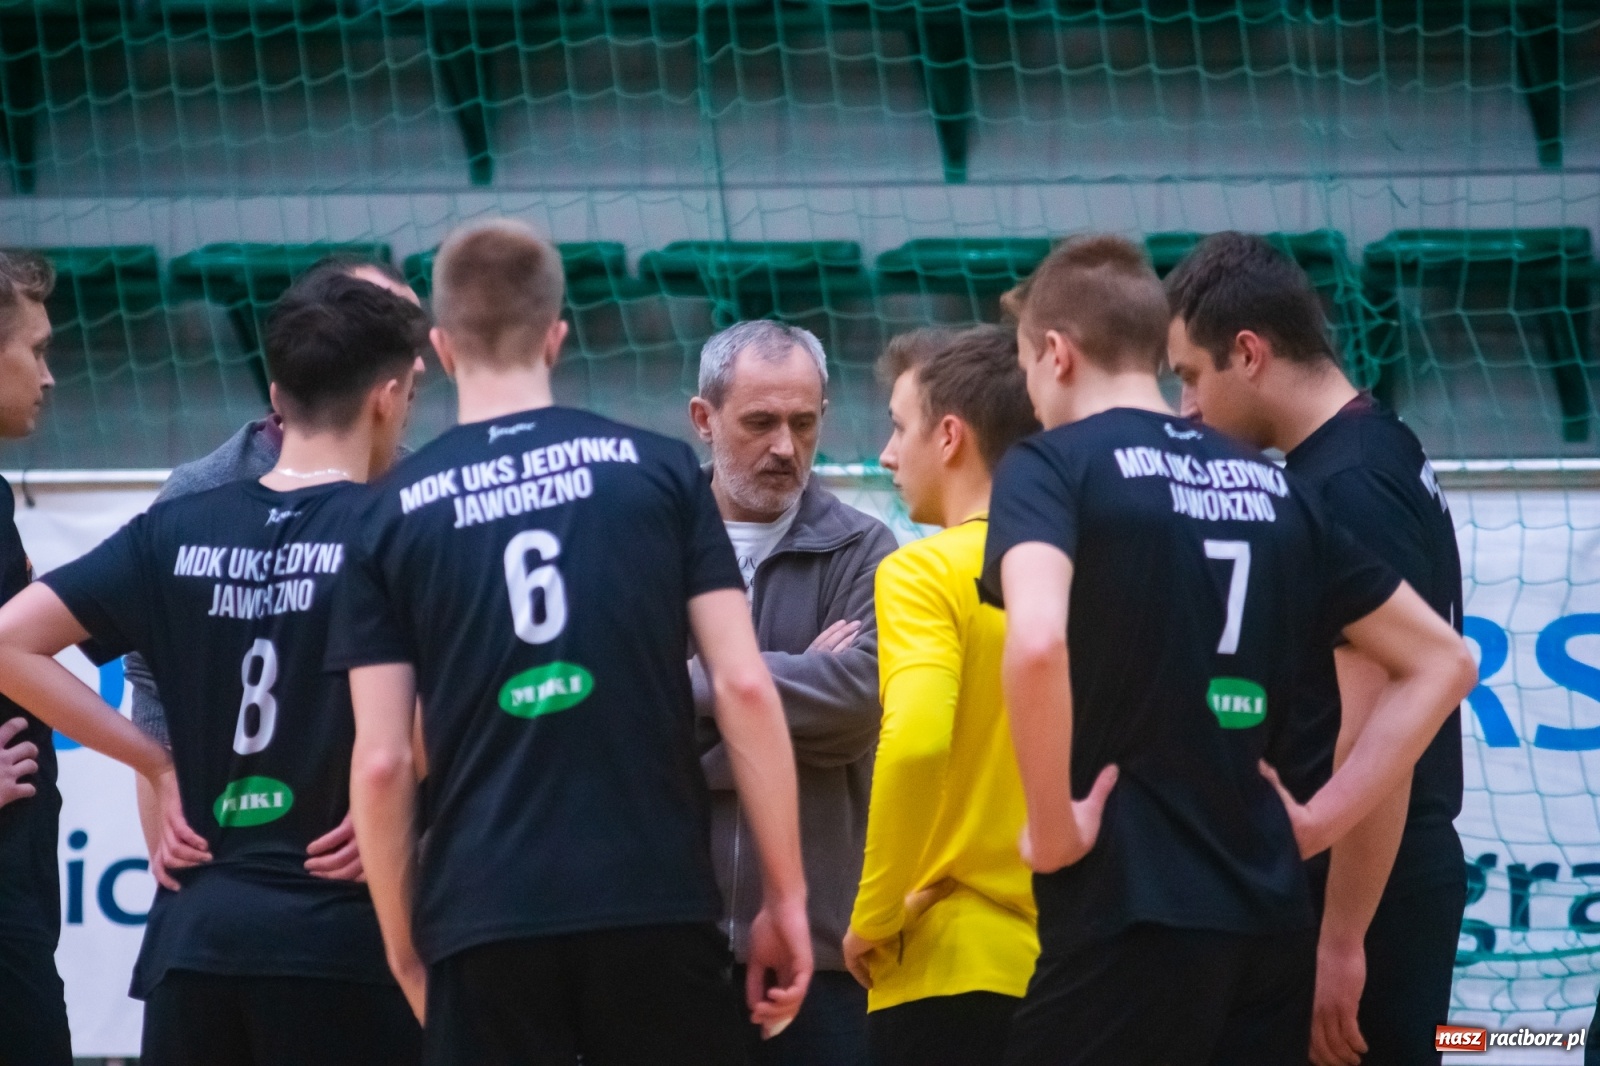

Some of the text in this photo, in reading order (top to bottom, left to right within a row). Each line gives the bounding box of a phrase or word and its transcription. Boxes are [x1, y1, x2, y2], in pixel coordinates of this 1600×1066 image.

[400, 437, 639, 514] MDK UKS JEDYNKA
[1114, 446, 1170, 478] MDK
[453, 466, 593, 529] JAWORZNO
[1169, 482, 1276, 522] JAWORZNO
[173, 545, 226, 577] MDK
[504, 529, 567, 645] 6
[207, 578, 313, 619] JAWORZNO
[1203, 539, 1250, 654] 7
[232, 638, 278, 755] 8
